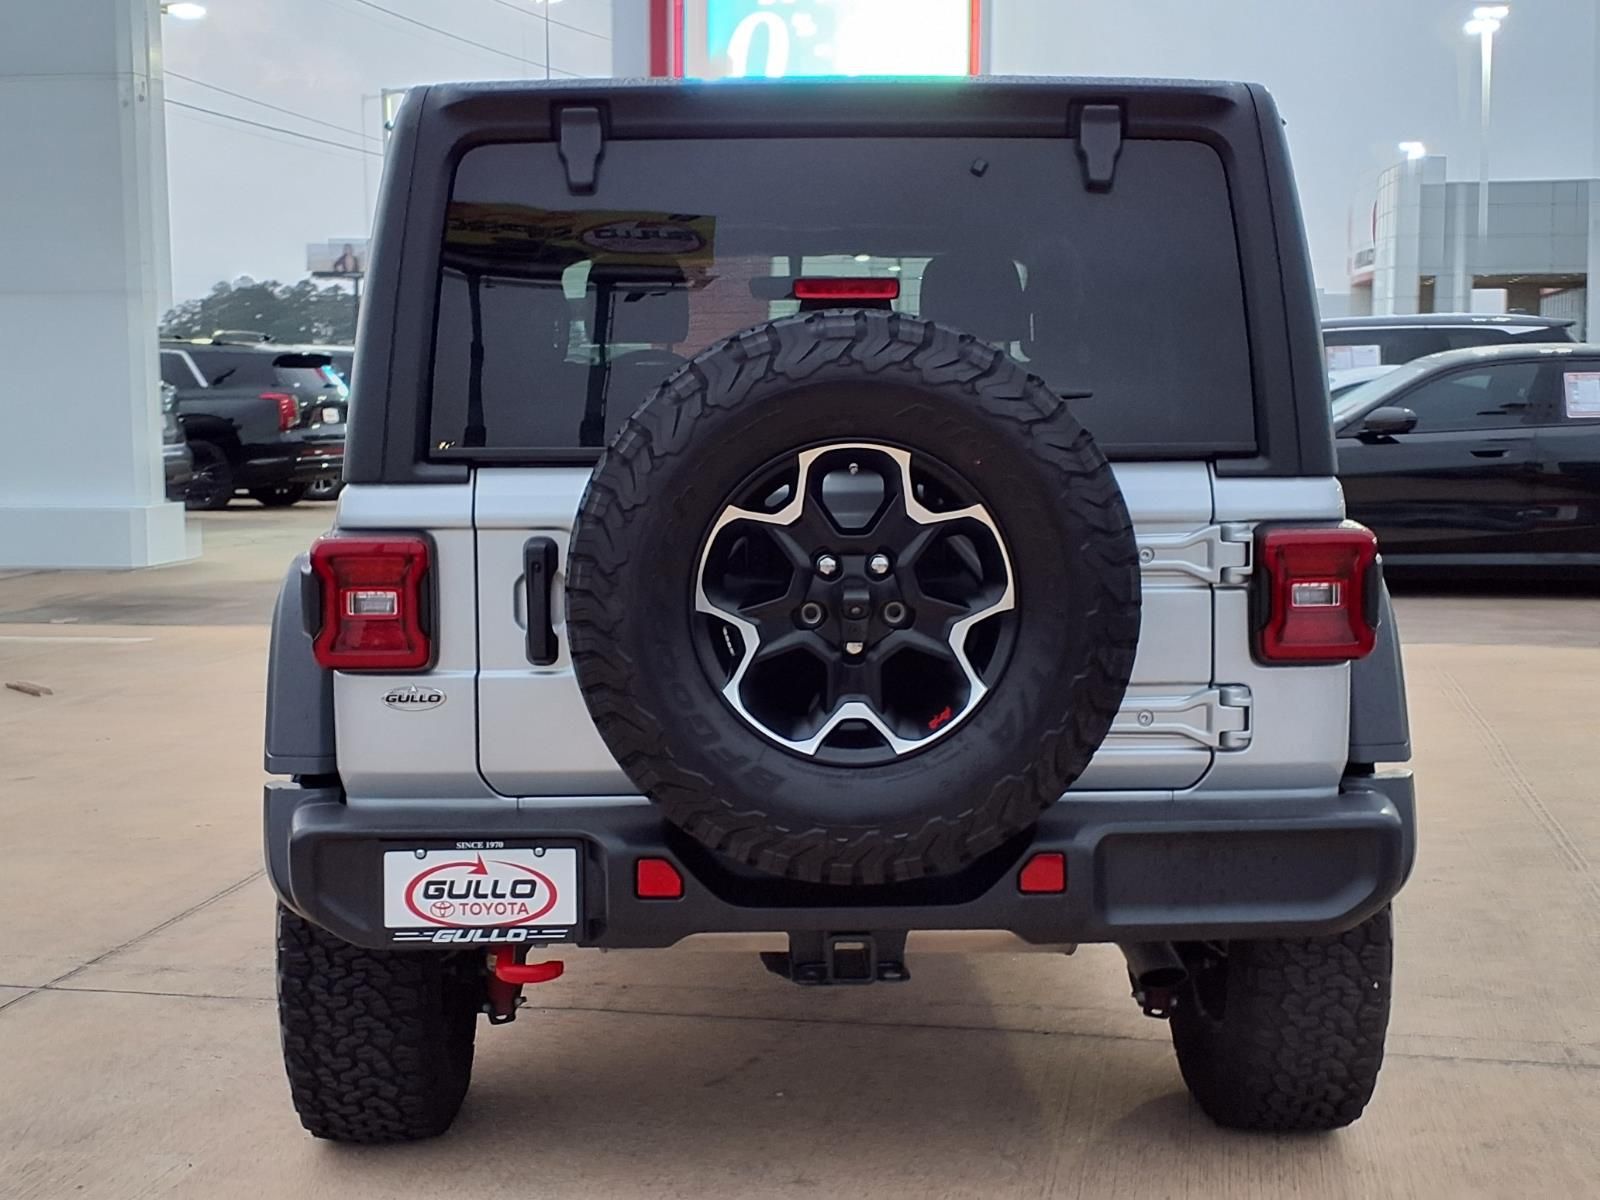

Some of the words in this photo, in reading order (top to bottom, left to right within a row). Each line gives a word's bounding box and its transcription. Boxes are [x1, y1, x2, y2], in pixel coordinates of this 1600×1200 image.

[385, 694, 442, 703] GULLO
[455, 841, 484, 849] SINCE
[486, 841, 505, 849] 1970
[422, 878, 537, 900] GULLO
[459, 901, 530, 916] TOYOTA
[432, 928, 528, 943] GULLO
